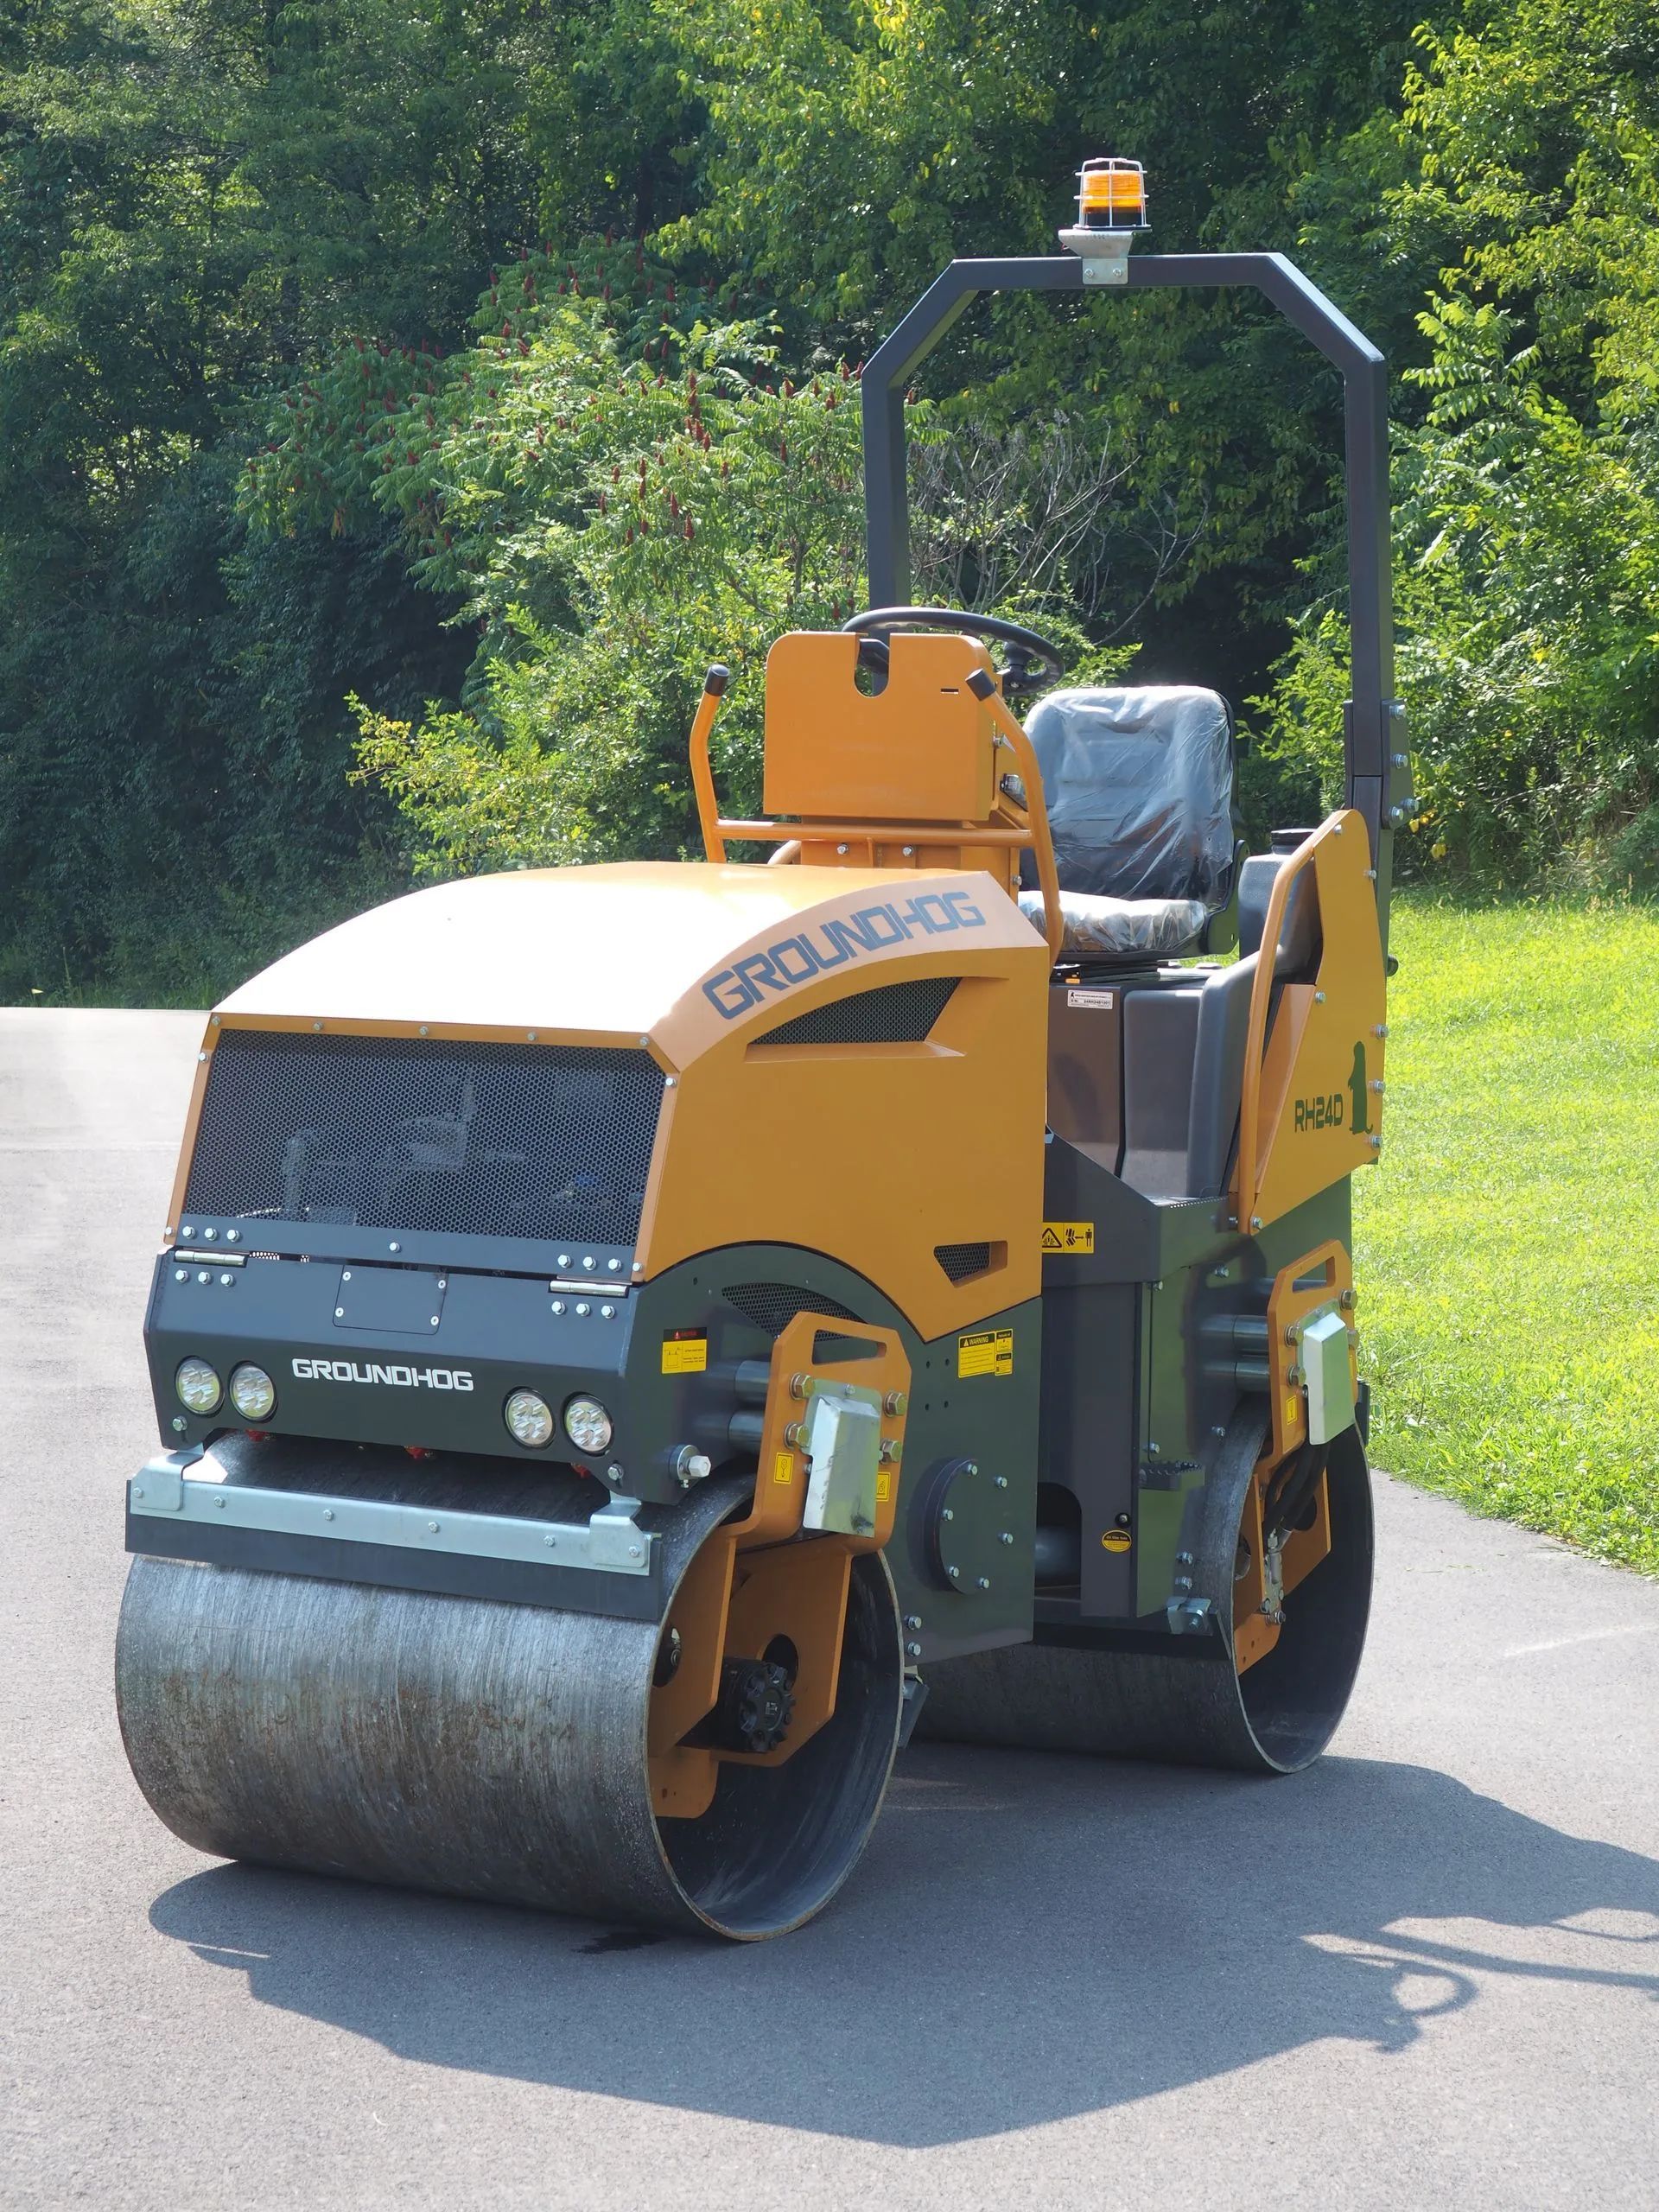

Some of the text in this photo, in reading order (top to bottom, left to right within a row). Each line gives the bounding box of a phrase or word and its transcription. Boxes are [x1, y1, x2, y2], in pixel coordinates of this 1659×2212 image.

[702, 891, 987, 1020] GROUNDHOG
[969, 1336, 989, 1345] WARNING
[291, 1357, 474, 1391] GROUNDHOG
